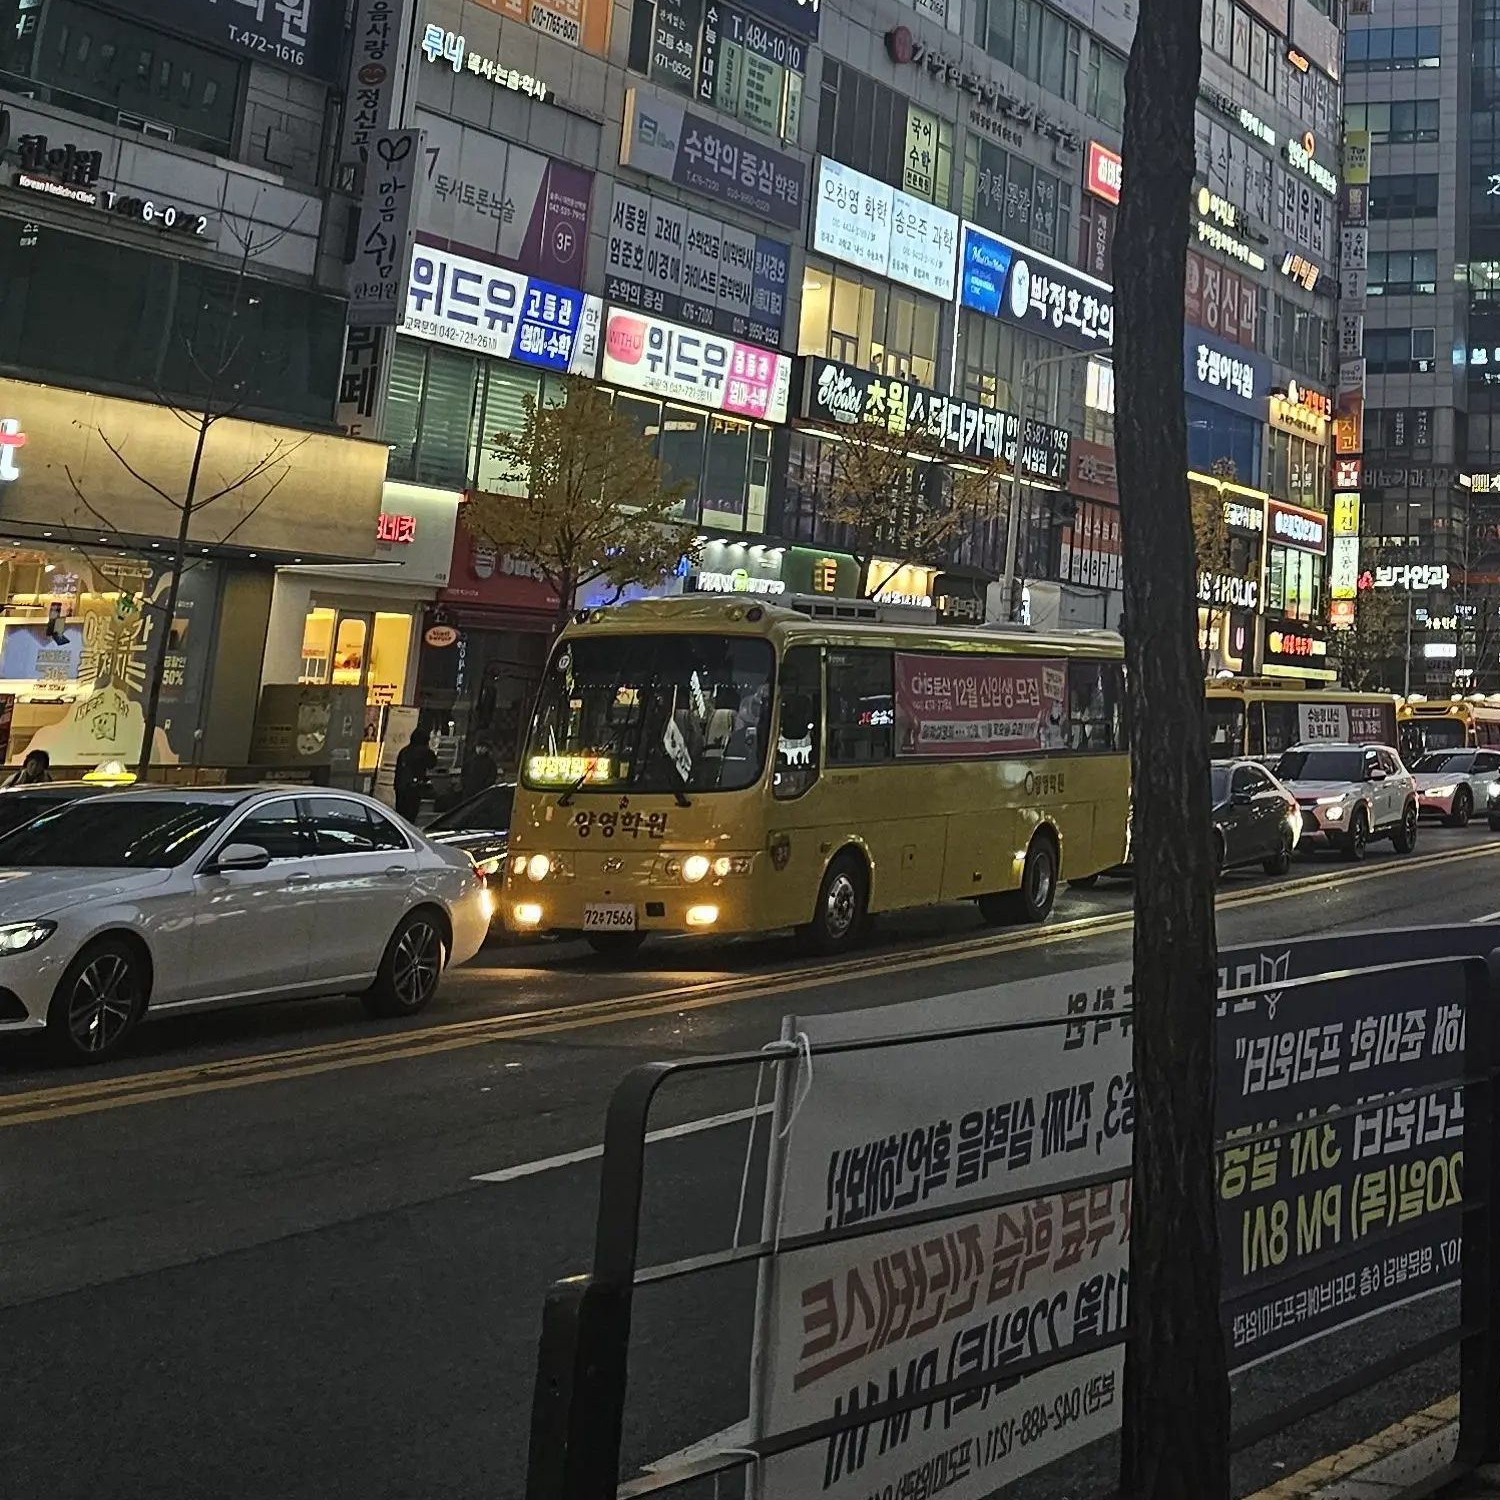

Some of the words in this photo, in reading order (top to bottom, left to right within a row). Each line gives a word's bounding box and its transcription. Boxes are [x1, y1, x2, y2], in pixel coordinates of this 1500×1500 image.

[227, 23, 305, 67] T.472-1616
[675, 38, 694, 59] 수학
[745, 23, 801, 69] 484-1010
[911, 116, 933, 147] 국어
[908, 144, 933, 175] 수학
[434, 175, 516, 225] 독서토론논술
[774, 172, 800, 206] 학원
[822, 179, 860, 216] 오창영
[612, 200, 648, 237] 서동원
[894, 209, 929, 241] 송은주
[555, 230, 574, 253] 3F
[610, 236, 645, 272] 엄준호
[409, 257, 517, 334] 위드유
[525, 288, 573, 327] 고등관
[608, 278, 642, 307] 수학의
[642, 287, 665, 313] 중심
[1202, 265, 1259, 344] 정신과
[645, 326, 729, 391] 위드유
[1375, 564, 1450, 590] 보다안과
[952, 678, 978, 709] 12월
[978, 676, 1014, 709] 신입생
[1015, 676, 1041, 707] 모집
[574, 810, 669, 840] 양영학원
[584, 909, 634, 928] 727566
